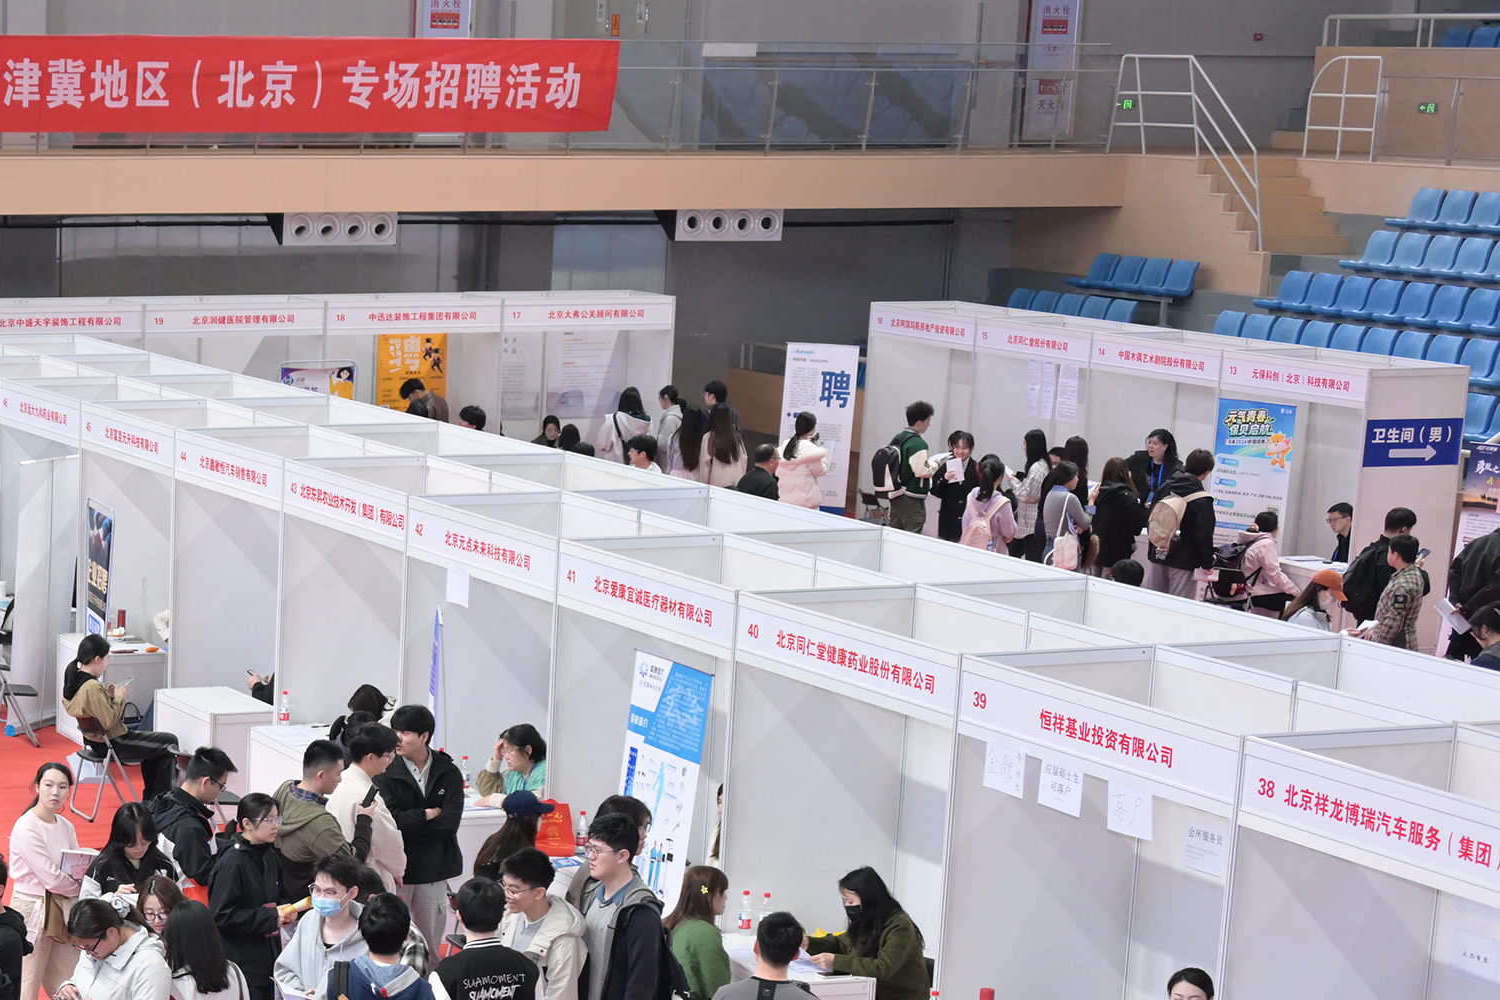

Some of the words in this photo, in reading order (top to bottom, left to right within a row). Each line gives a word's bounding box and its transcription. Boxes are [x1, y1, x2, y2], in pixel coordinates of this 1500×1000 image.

[1042, 5, 1070, 15] 消火栓
[154, 317, 165, 325] 19
[192, 314, 295, 326] 北京润健医院管理有限公司
[336, 313, 346, 322] 18
[368, 311, 477, 322] 中迅达装饰工程集团有限公司
[512, 311, 522, 319] 17
[877, 316, 883, 324] 16
[982, 331, 988, 340] 15
[1007, 334, 1069, 352] 北京同仁堂股份有限公司
[1099, 347, 1106, 357] 14
[1118, 350, 1206, 372] 中国木偶艺术剧院股份有限公司
[1230, 366, 1237, 375] 13
[1252, 368, 1351, 392] 元保科创（北京）科技有限公司
[819, 370, 851, 409] 聘
[3, 397, 8, 407] 46
[85, 421, 92, 433] 45
[1229, 423, 1274, 437] 保贝启航
[1371, 425, 1453, 444] 卫生间（男）
[180, 450, 187, 462] 44
[290, 481, 298, 495] 43
[415, 522, 424, 537] 42
[444, 529, 531, 572] 北京元点未来科技有限公司
[567, 568, 576, 584] 41
[593, 574, 713, 628] 北京爱康宜诚医疗器材有限公司
[747, 622, 760, 640] 40
[775, 628, 936, 696] 北京同仁堂健康药业股份有限公司
[972, 690, 988, 710] 39
[1039, 707, 1174, 770] 恒祥基业投资有限公司
[1044, 763, 1080, 785] 应届硕士生
[1050, 780, 1071, 796] 可落户
[1257, 777, 1276, 799] 38
[1188, 826, 1223, 847] 会所服务员
[462, 973, 526, 989] SUAMOMENT
